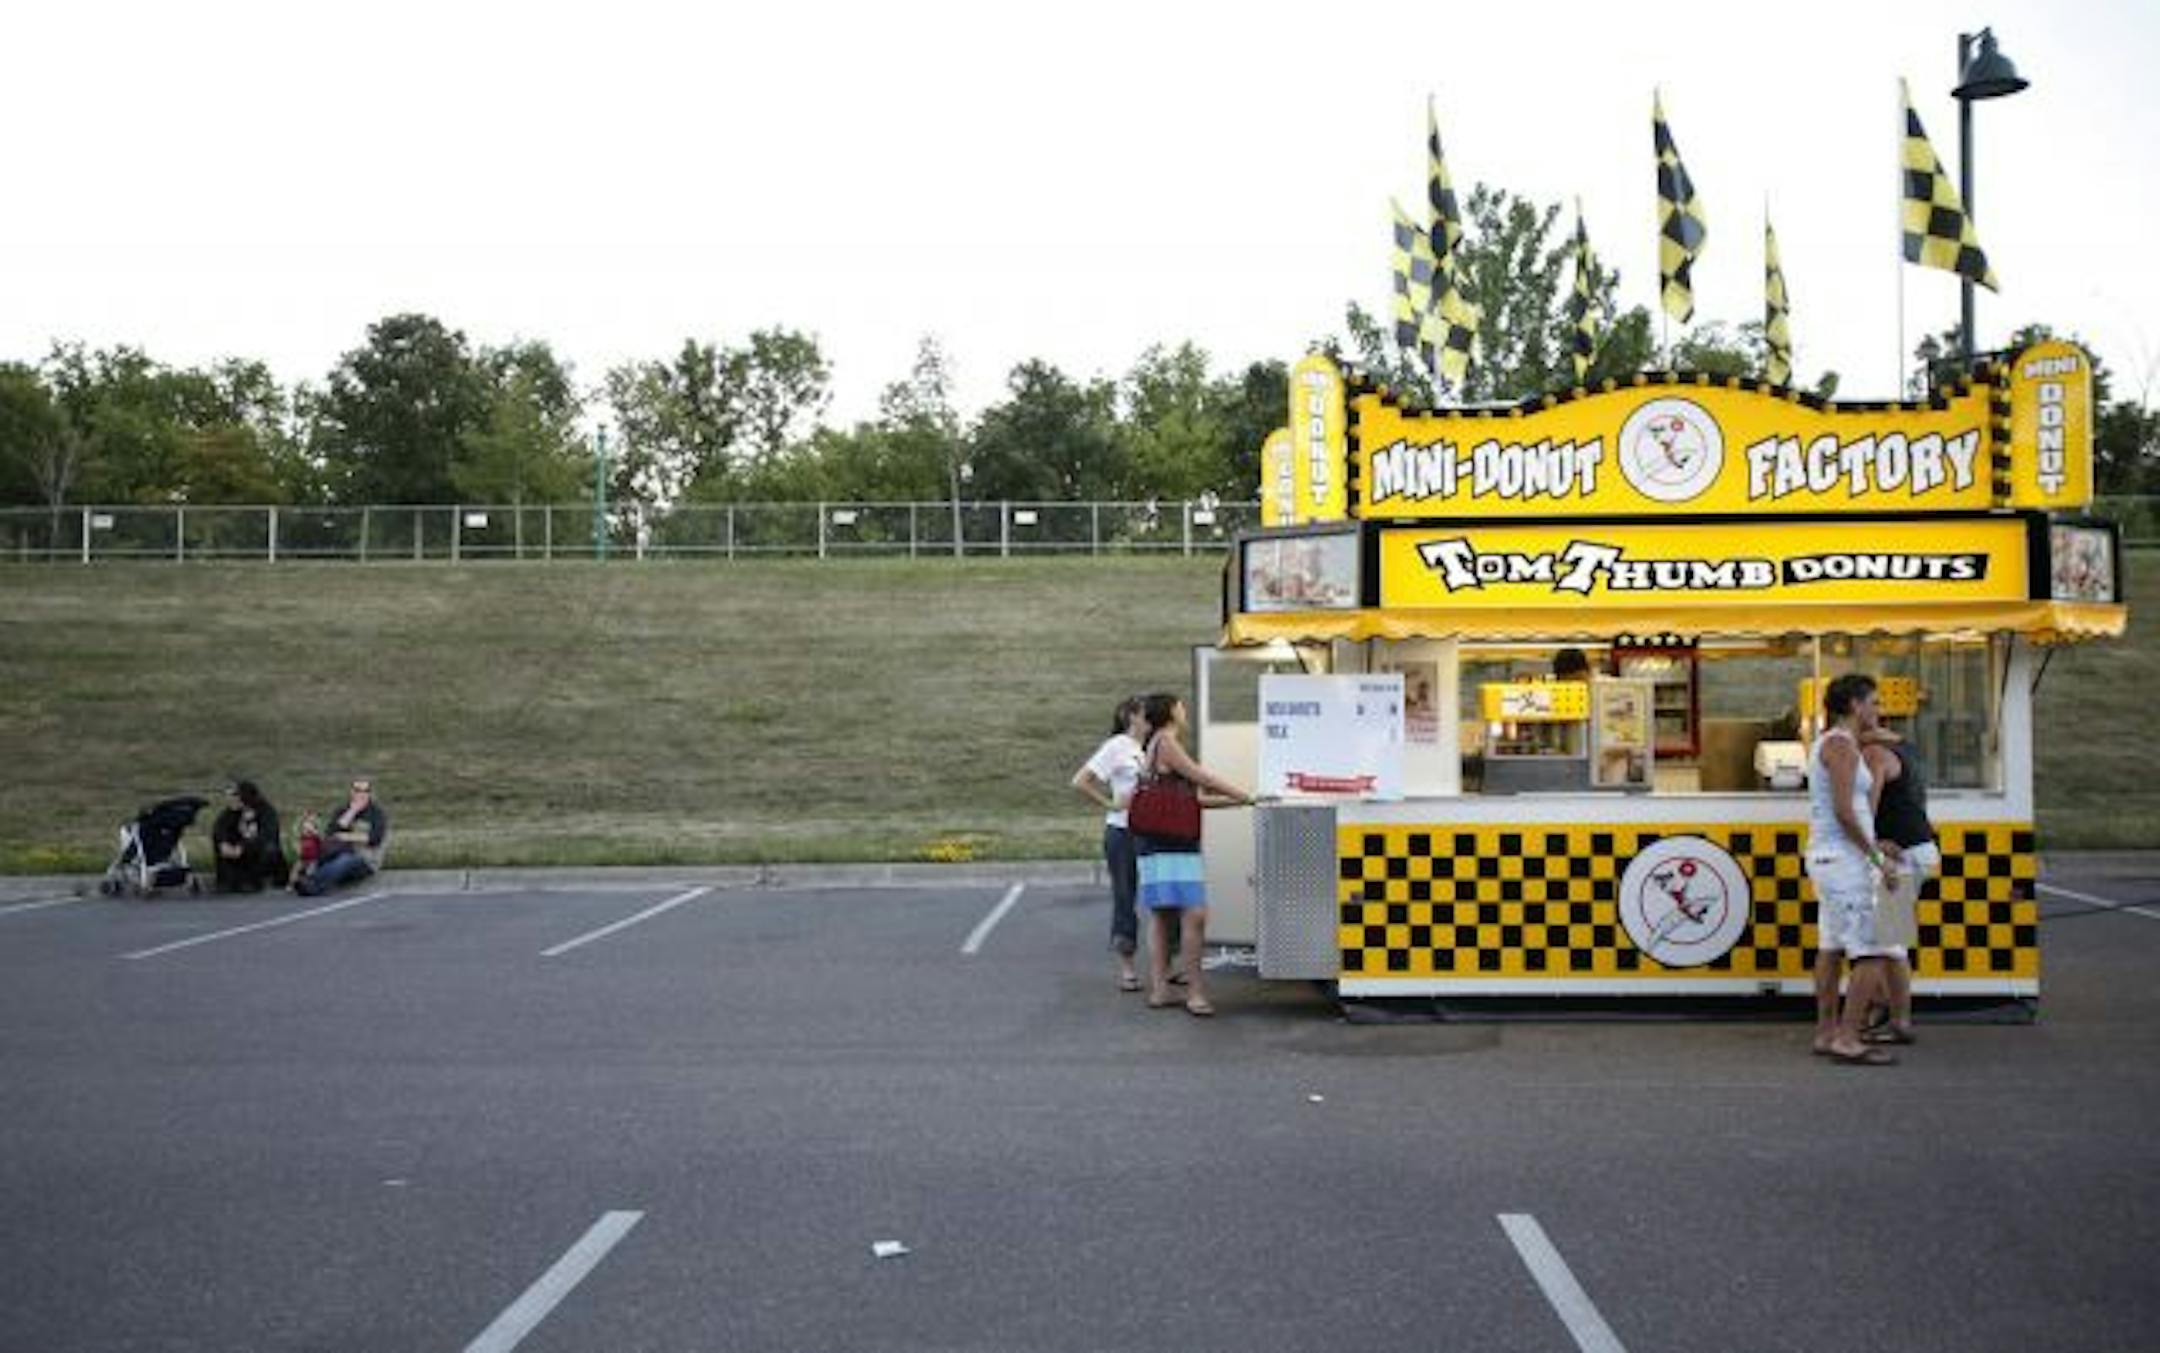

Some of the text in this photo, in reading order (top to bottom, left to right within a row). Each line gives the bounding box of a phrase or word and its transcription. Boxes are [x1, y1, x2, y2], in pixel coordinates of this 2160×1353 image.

[1372, 436, 1603, 502] MINI-DONUT
[1746, 429, 1980, 500] FACTORY
[2038, 384, 2064, 493] DONUT
[1553, 539, 1776, 595] THUMB
[1788, 555, 1978, 581] DONUTS
